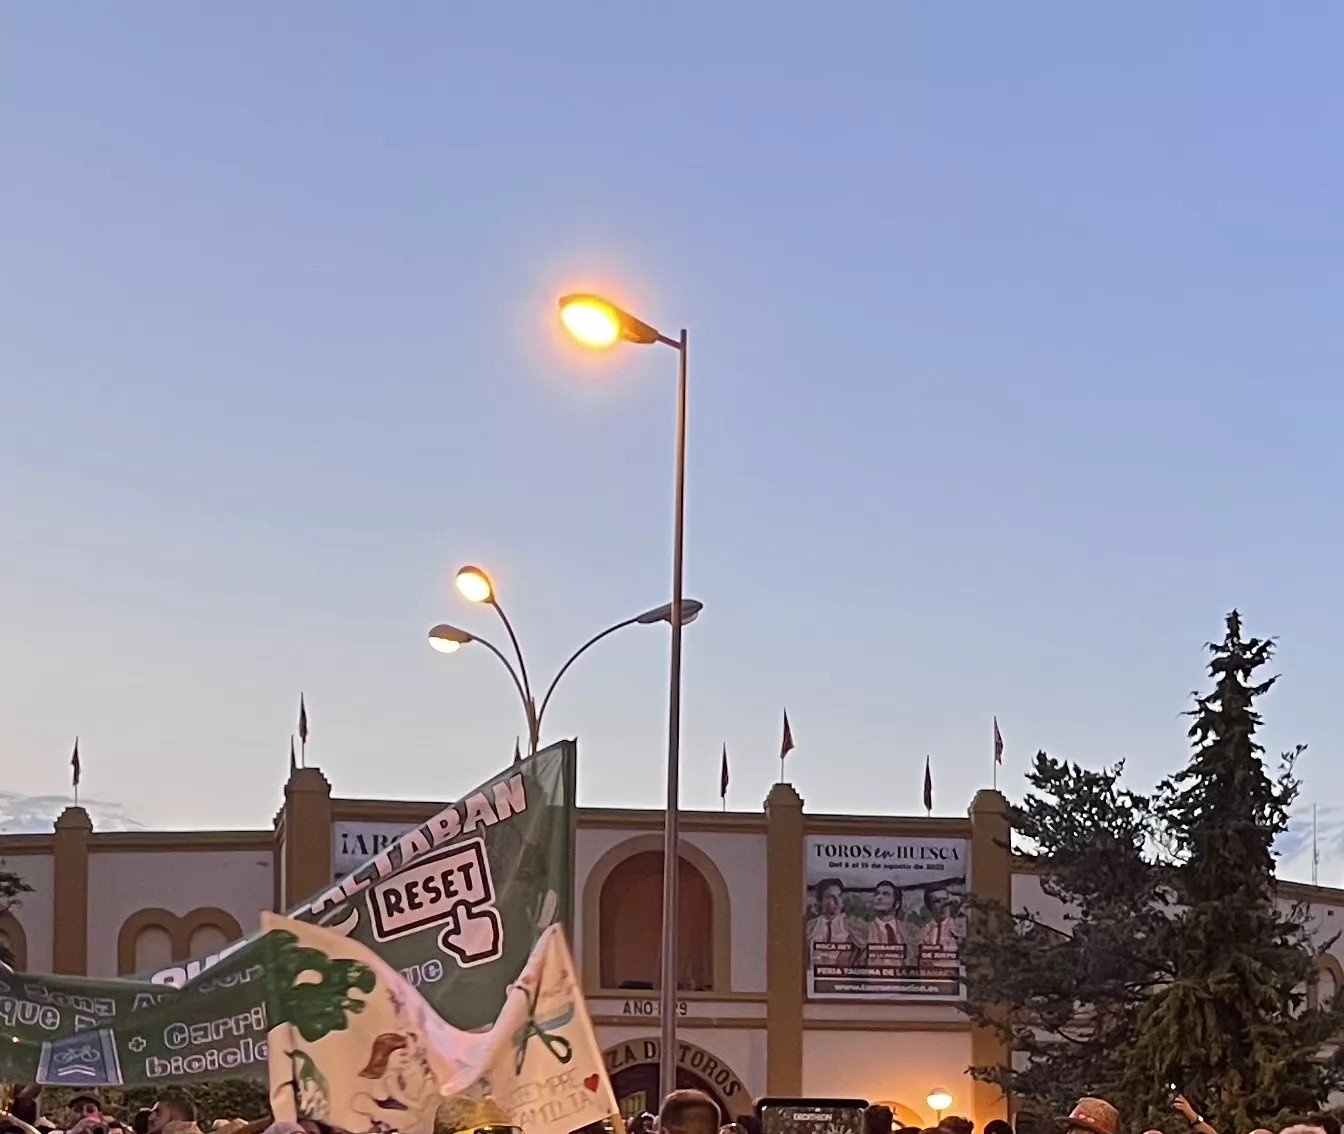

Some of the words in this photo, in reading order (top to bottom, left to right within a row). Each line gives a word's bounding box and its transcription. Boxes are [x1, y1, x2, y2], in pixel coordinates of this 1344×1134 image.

[814, 844, 872, 858] TOROS
[874, 847, 895, 859] en
[897, 846, 959, 860] HUESCA
[382, 862, 475, 918] RESET
[817, 967, 841, 975] FERIA
[679, 1044, 741, 1097] TOROS
